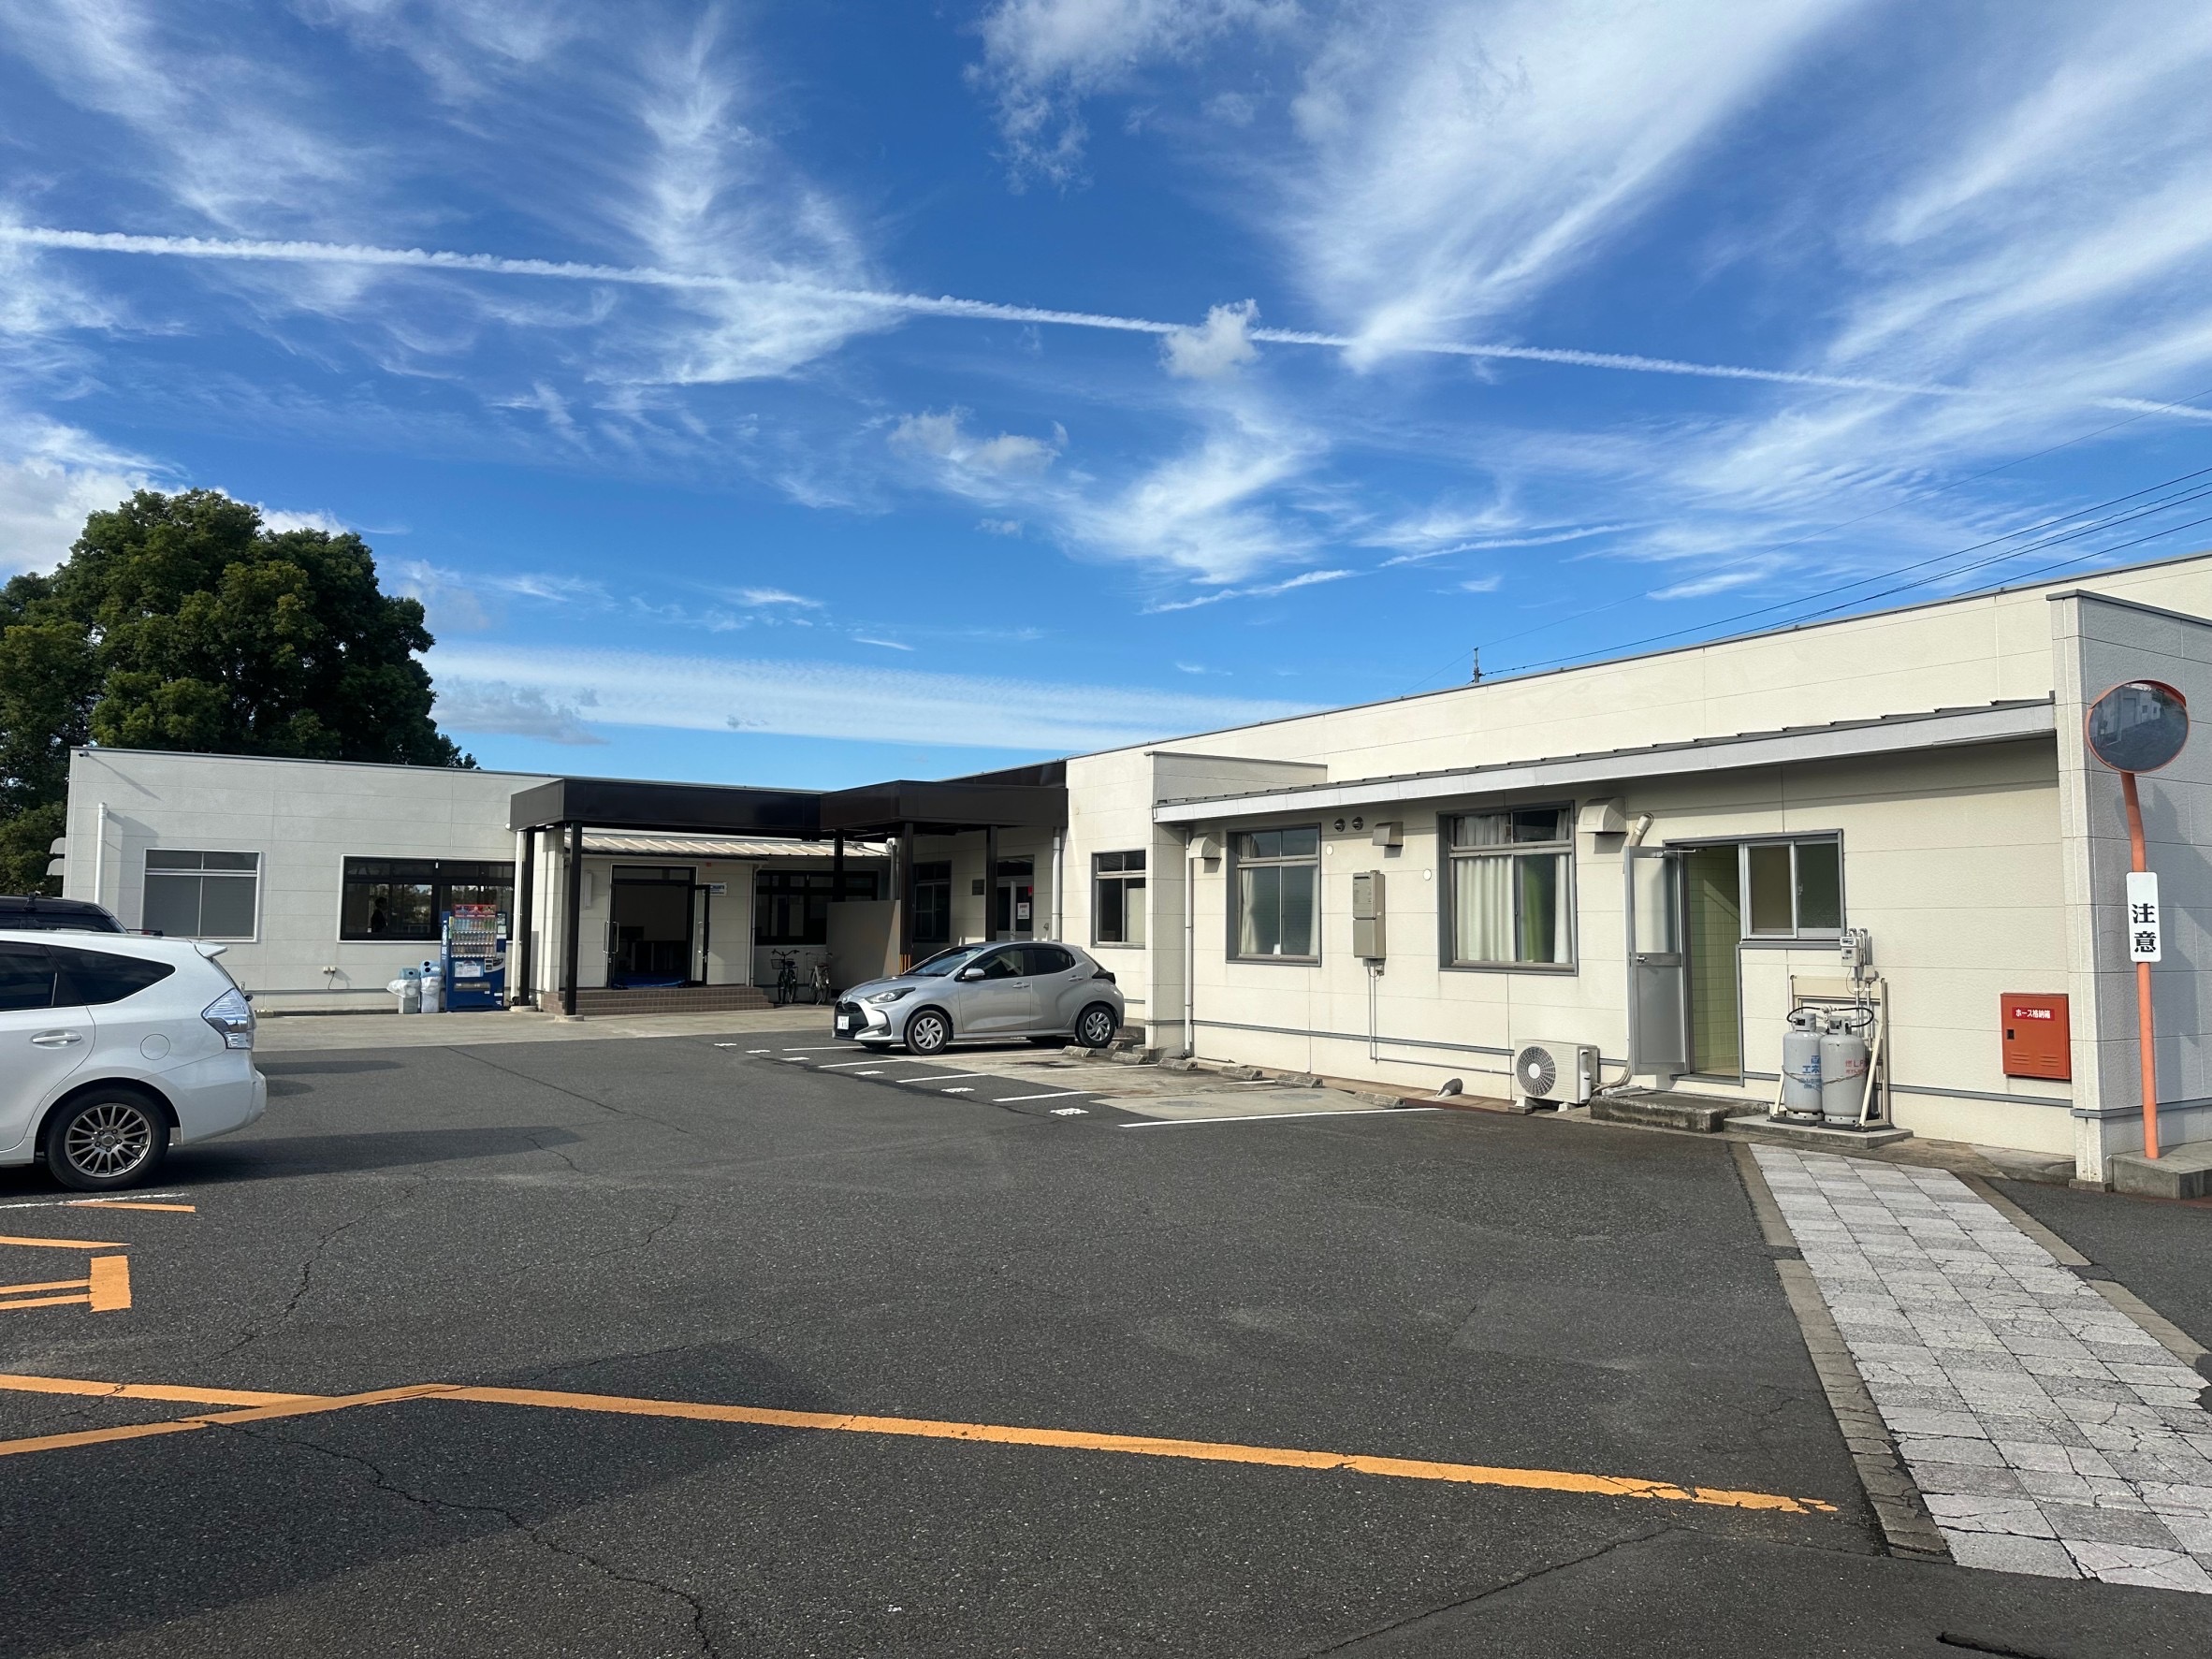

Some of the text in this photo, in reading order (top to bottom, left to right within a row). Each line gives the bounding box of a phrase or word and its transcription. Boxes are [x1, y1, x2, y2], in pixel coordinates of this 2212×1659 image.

[2132, 903, 2156, 953] 注意
[2016, 1008, 2051, 1019] ホース格納箱
